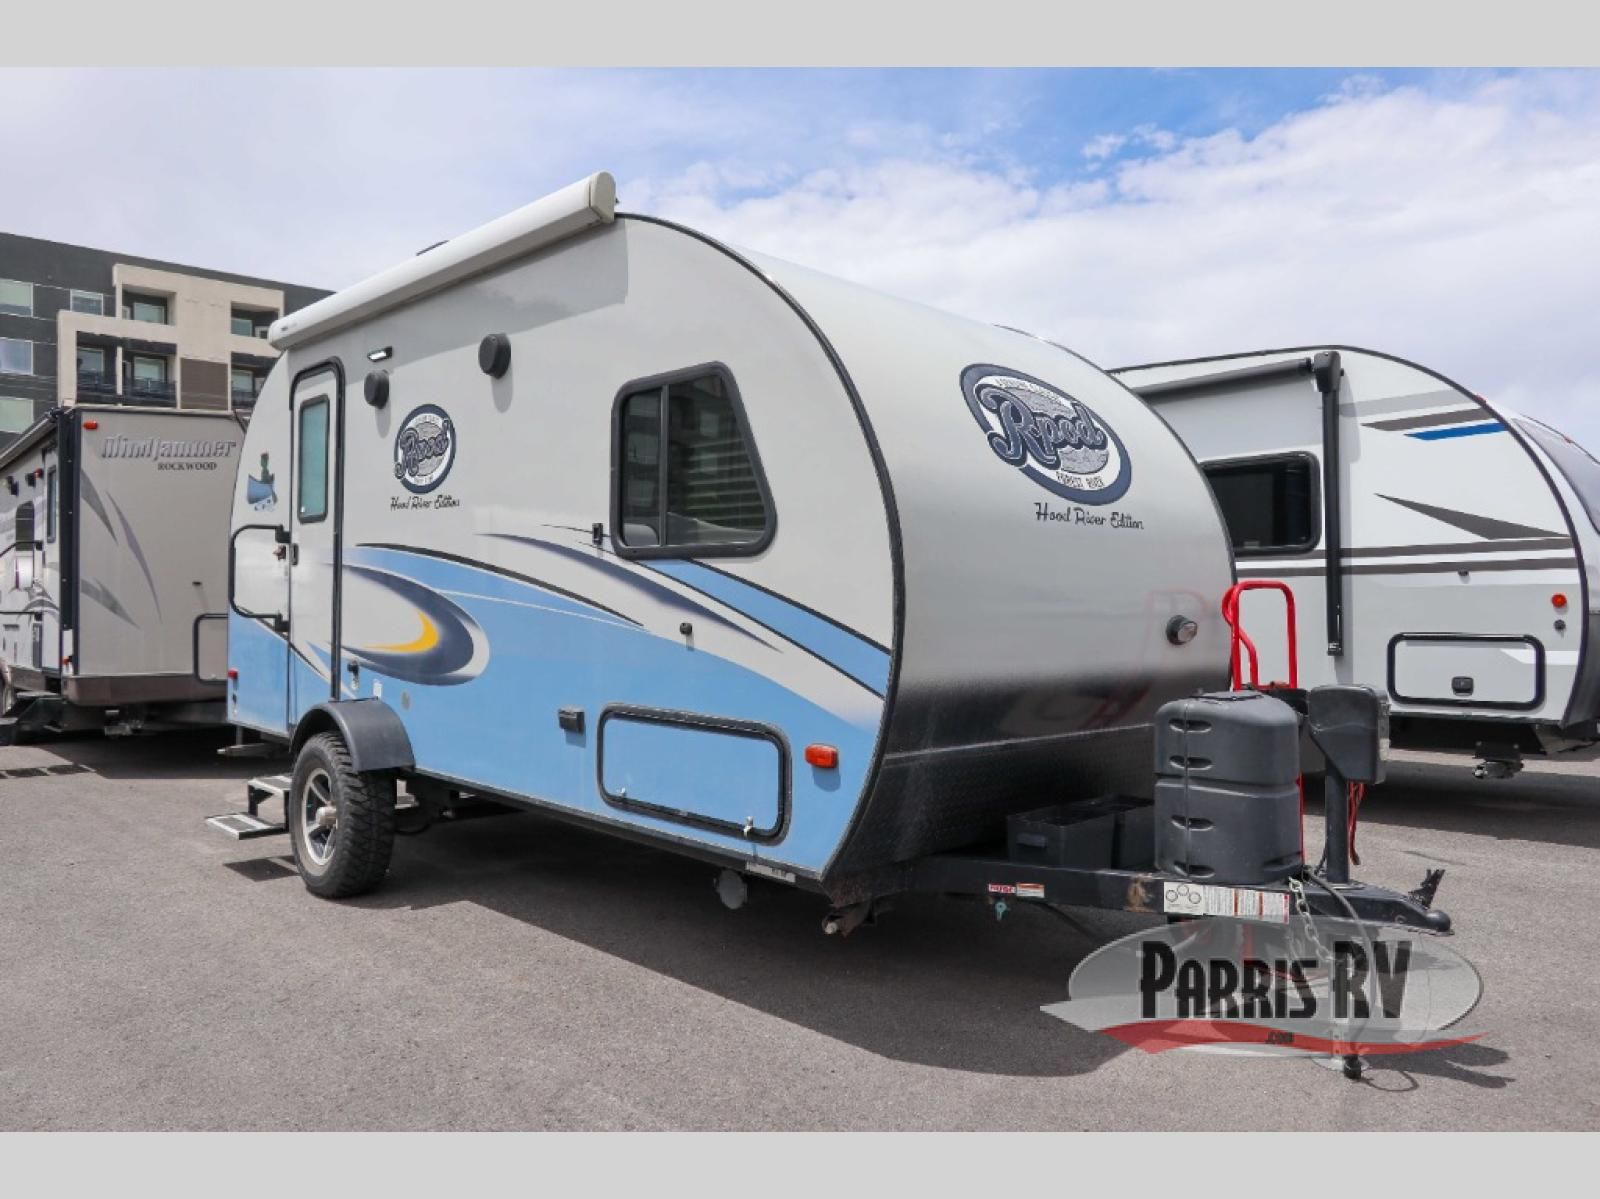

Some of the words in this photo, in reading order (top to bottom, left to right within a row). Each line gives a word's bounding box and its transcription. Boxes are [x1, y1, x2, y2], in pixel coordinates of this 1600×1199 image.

[157, 462, 218, 472] ROCKWOOD
[1034, 502, 1072, 523] Hood
[1074, 508, 1106, 526] River
[1109, 511, 1145, 531] Edition
